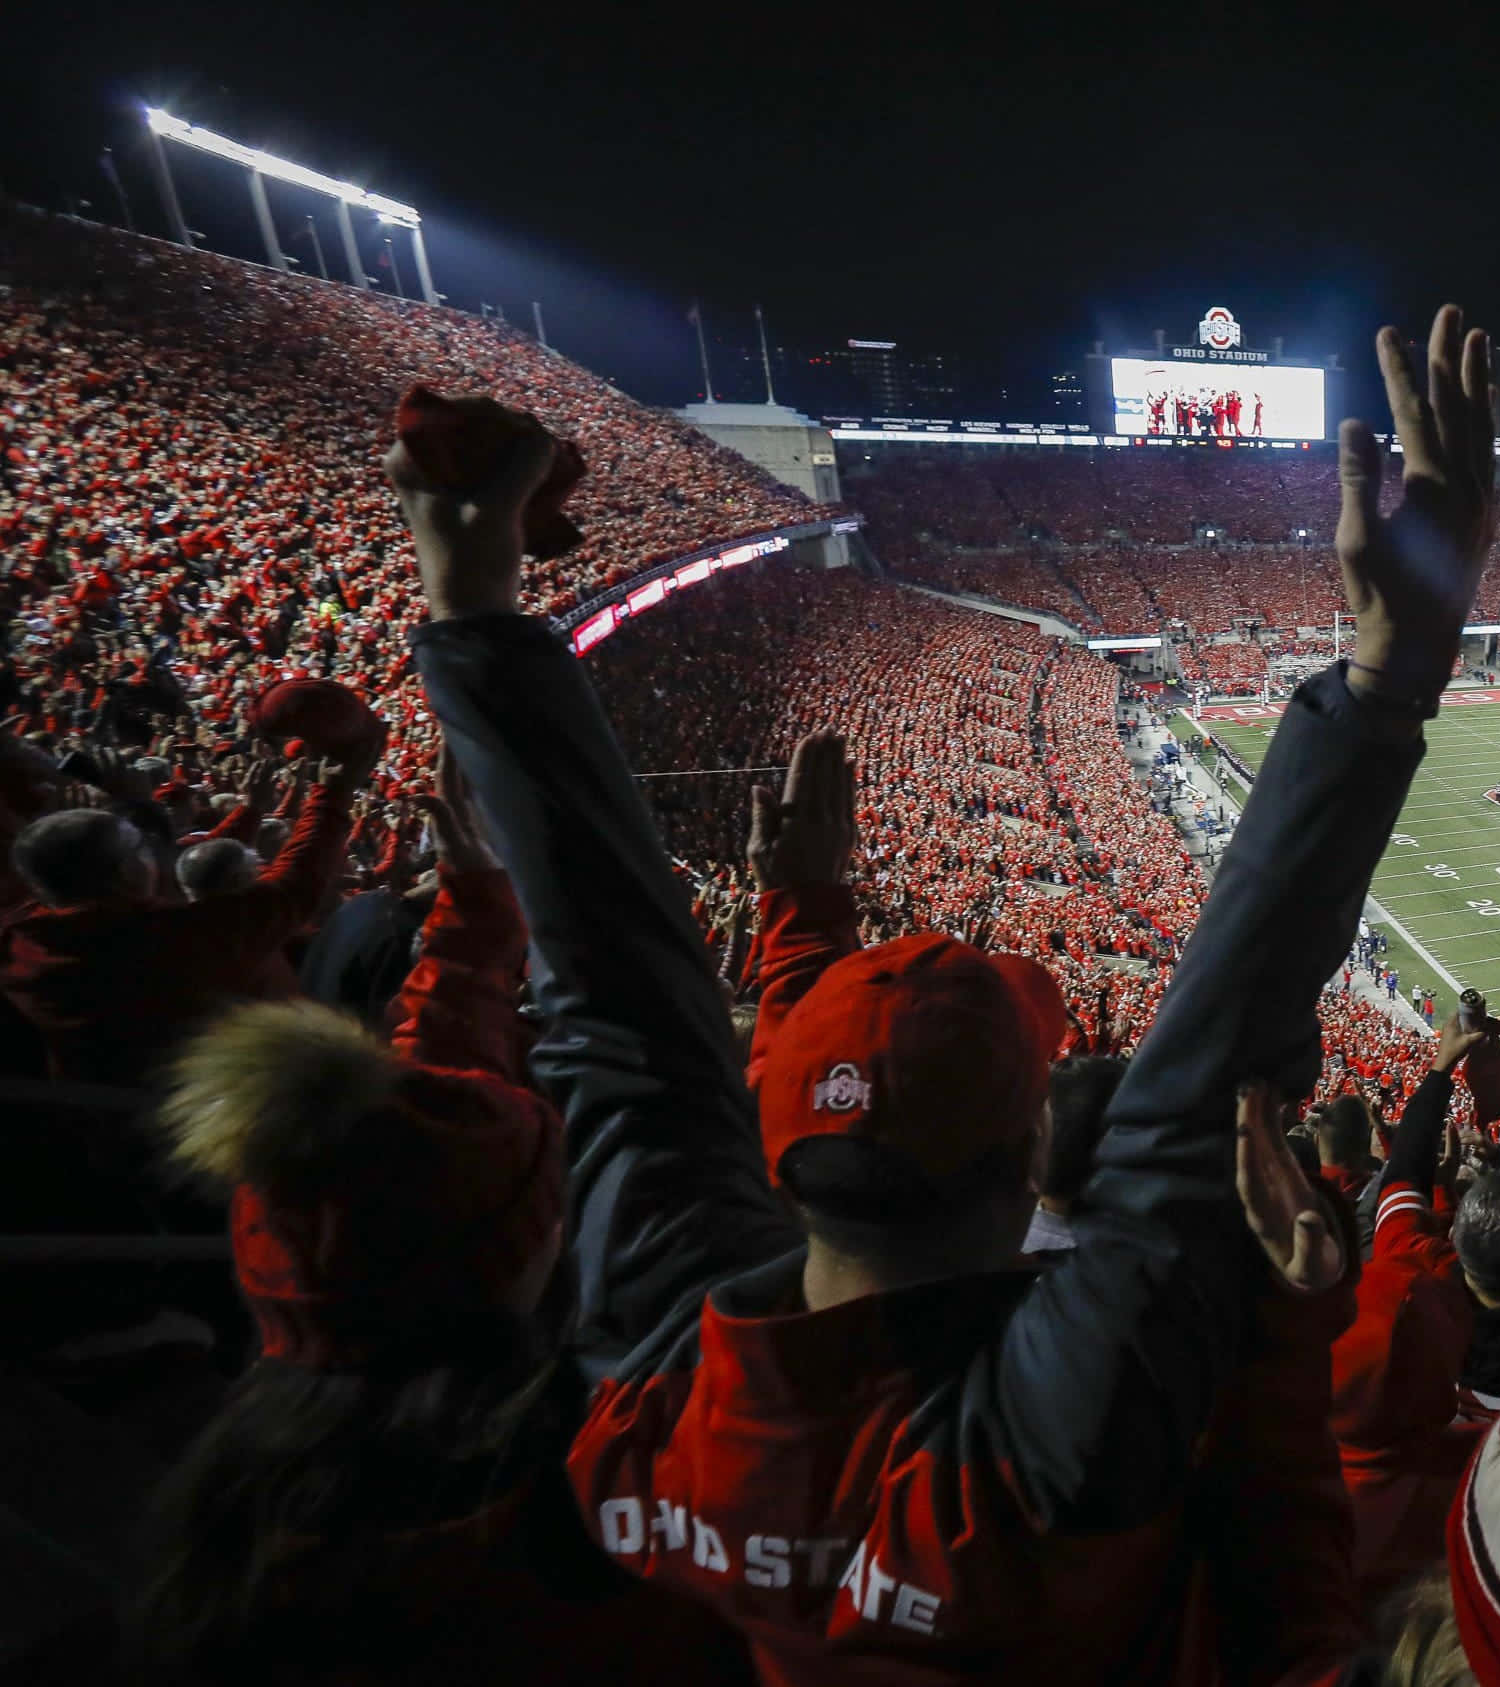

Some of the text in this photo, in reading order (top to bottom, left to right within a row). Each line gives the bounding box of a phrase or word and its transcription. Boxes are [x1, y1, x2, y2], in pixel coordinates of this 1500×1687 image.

[1173, 348, 1268, 361] OHIO STADIUM
[1425, 863, 1457, 879] 30
[745, 1534, 941, 1635] STATE
